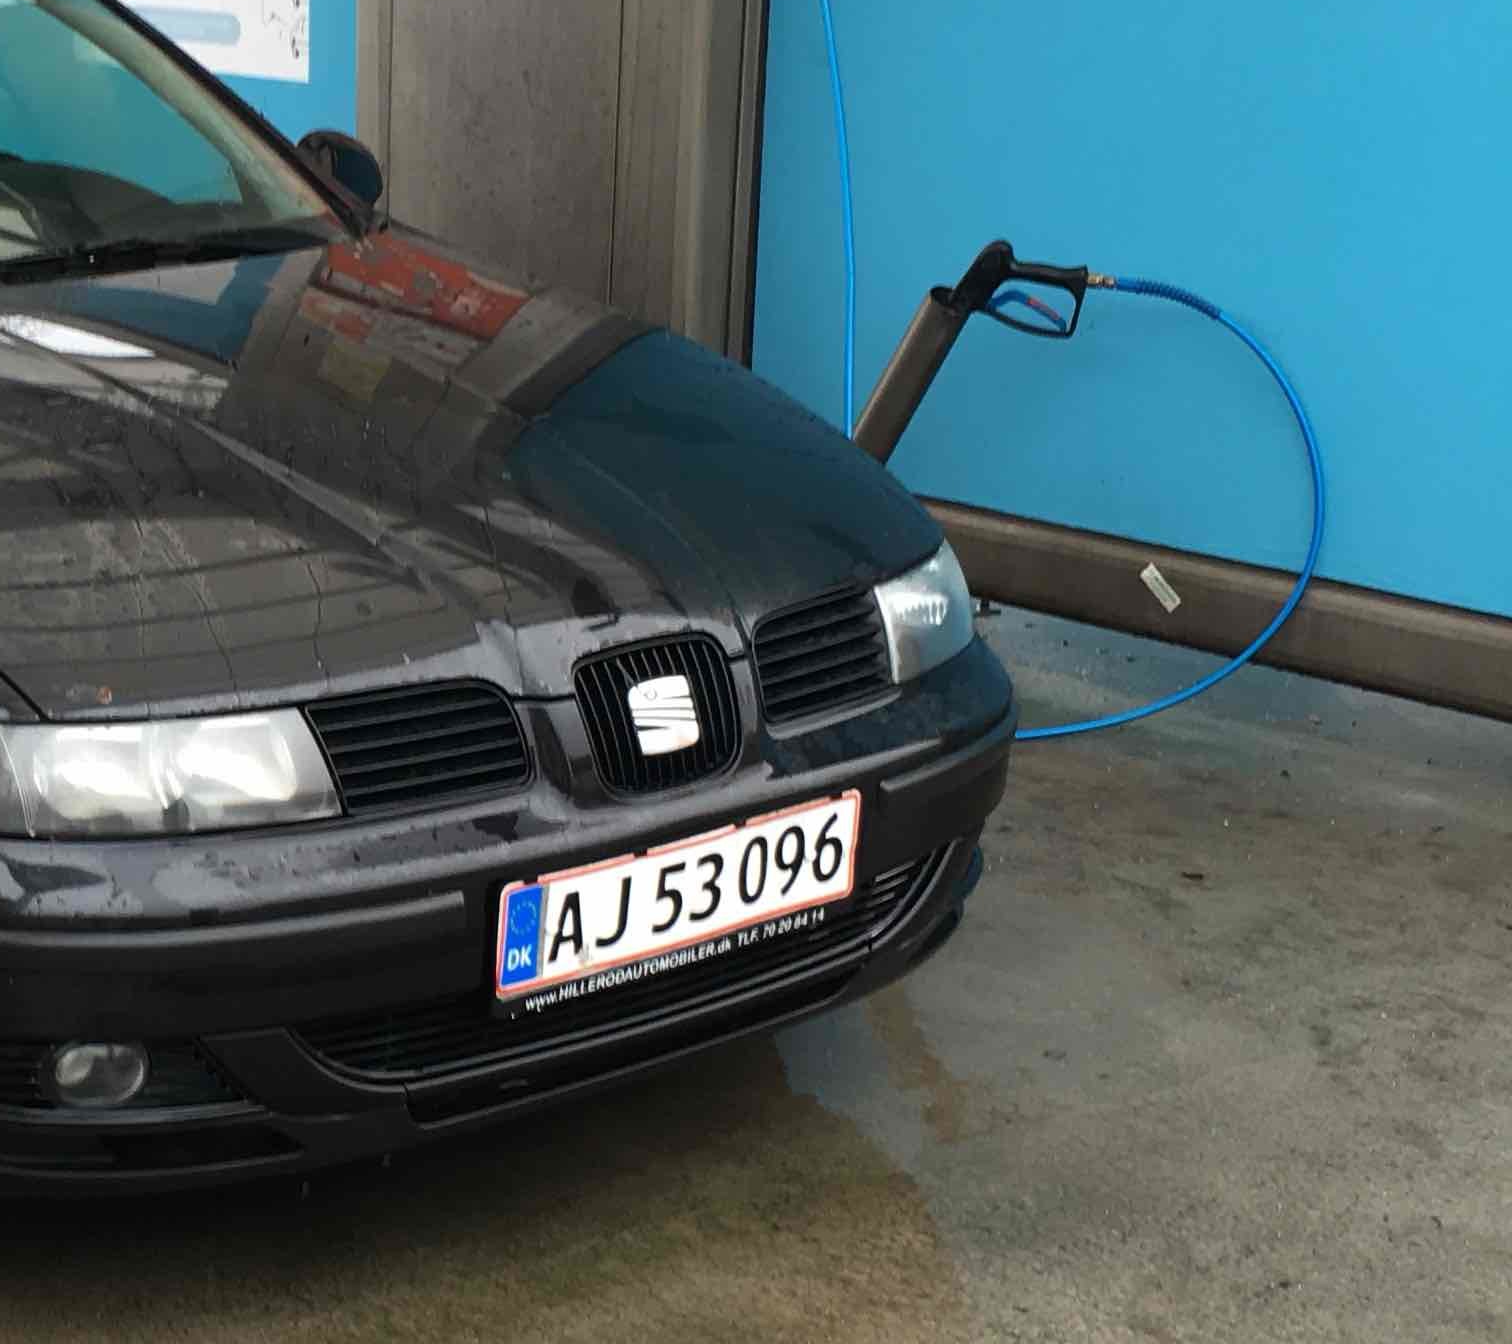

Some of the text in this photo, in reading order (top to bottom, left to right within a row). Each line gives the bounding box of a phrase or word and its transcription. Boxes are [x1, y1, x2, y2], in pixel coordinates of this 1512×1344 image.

[547, 811, 843, 963] AJ 53 096
[506, 943, 533, 972] DK
